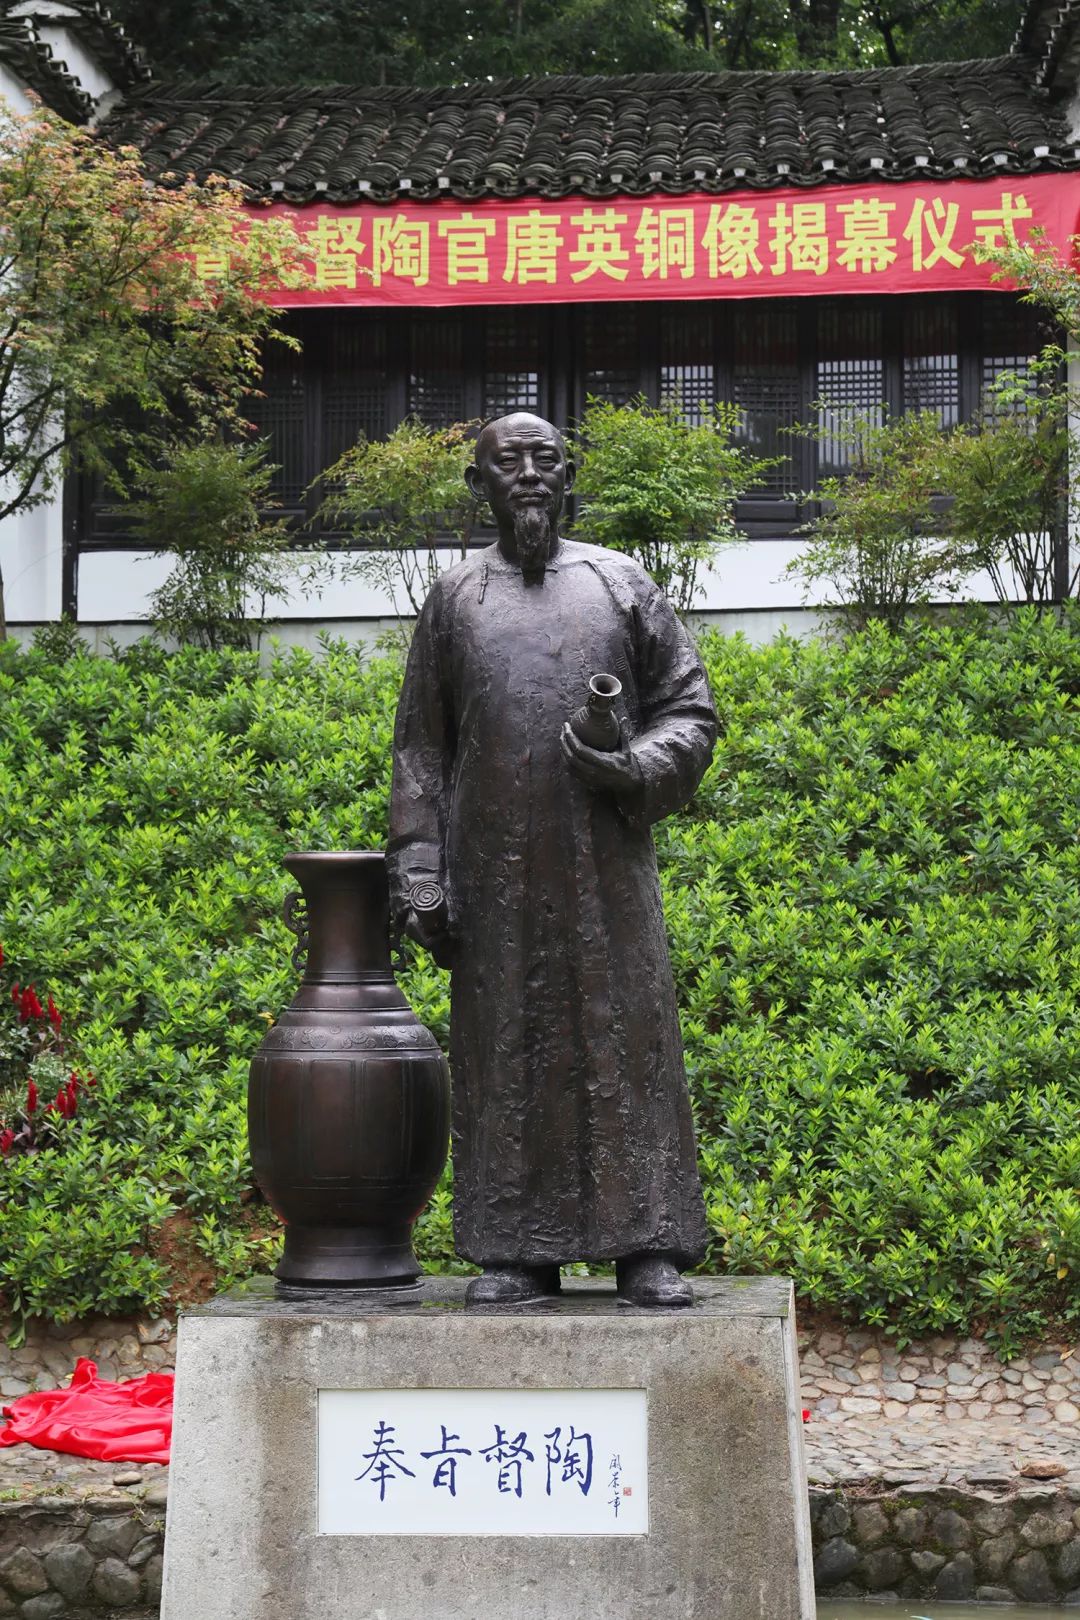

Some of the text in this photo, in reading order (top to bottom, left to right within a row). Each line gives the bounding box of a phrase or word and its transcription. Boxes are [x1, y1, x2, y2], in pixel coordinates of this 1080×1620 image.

[192, 192, 1033, 289] 督陶官唐英铜像揭幕仪式
